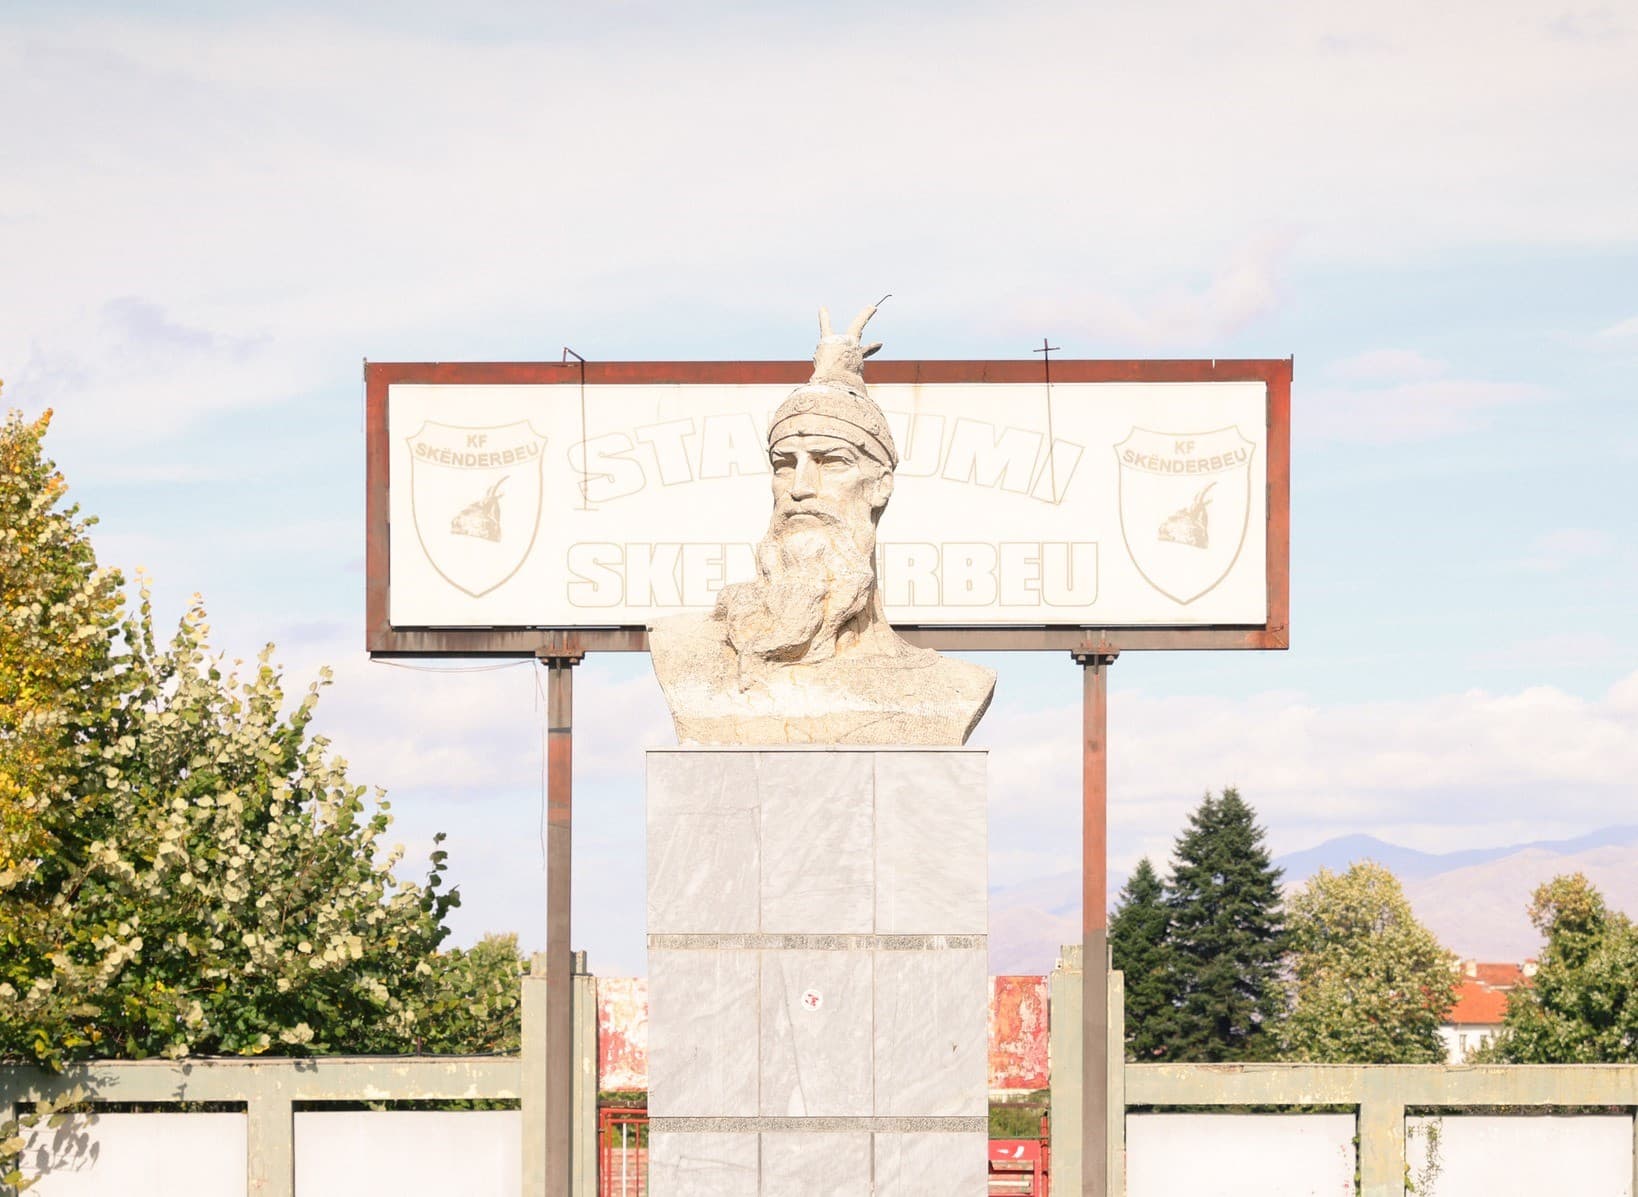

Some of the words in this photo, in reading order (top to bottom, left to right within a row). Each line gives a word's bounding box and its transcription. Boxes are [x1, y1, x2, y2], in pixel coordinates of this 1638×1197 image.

[415, 441, 539, 466] SKËNDERBEU
[465, 434, 488, 448] KF
[1174, 440, 1195, 454] KF
[567, 411, 1085, 505] STAUMI
[1123, 448, 1247, 473] SKËNDERBEU
[567, 542, 1098, 607] SKERBEU
